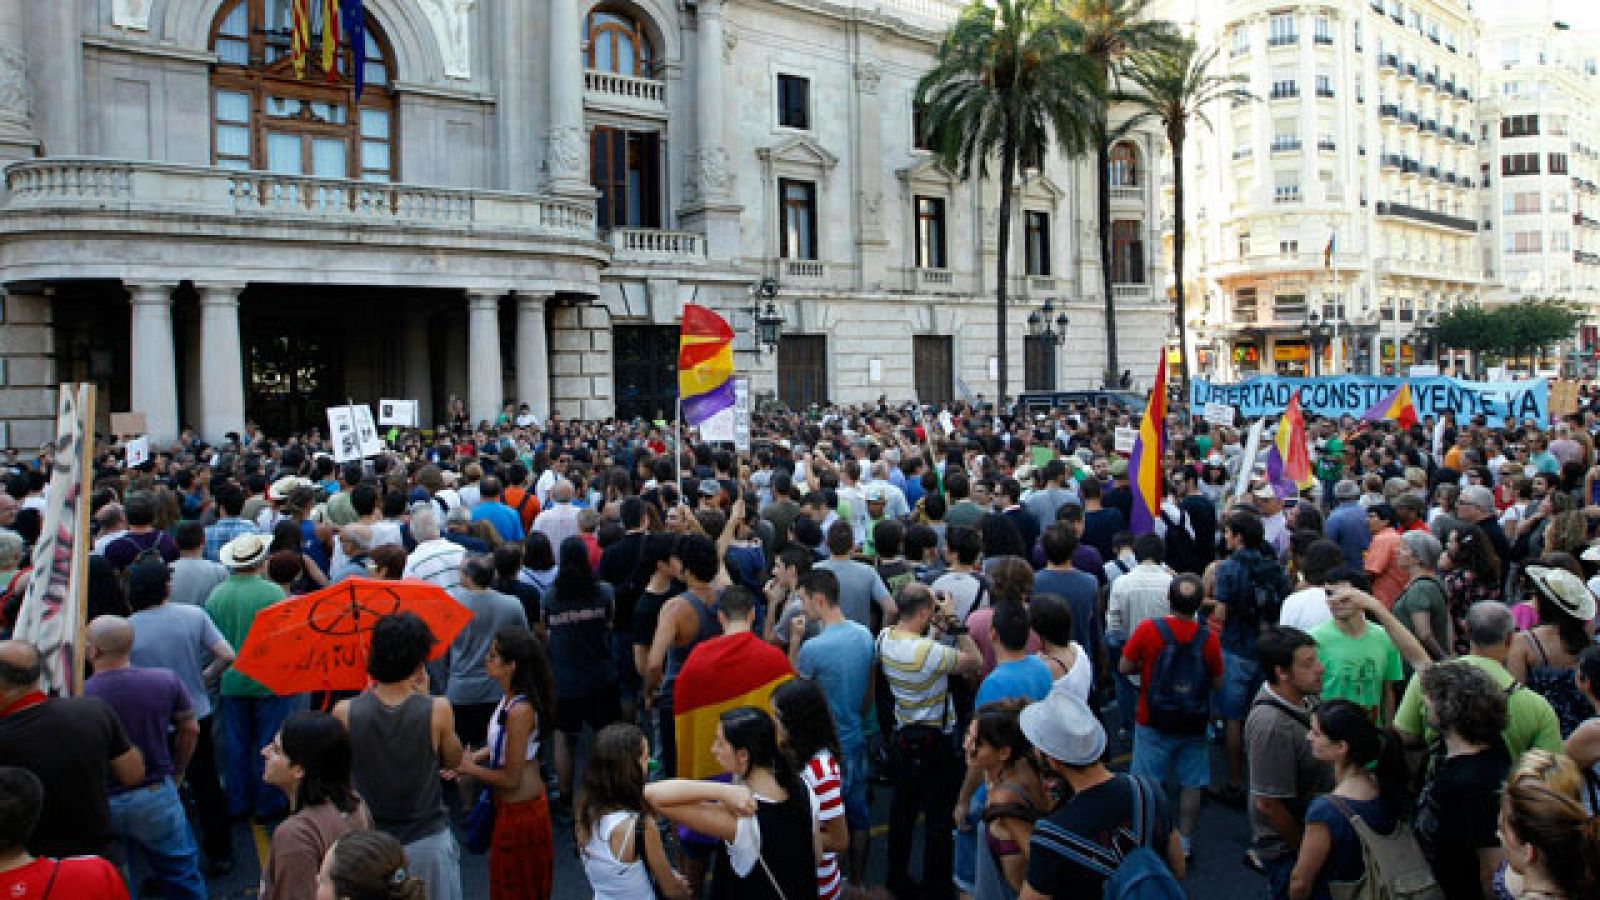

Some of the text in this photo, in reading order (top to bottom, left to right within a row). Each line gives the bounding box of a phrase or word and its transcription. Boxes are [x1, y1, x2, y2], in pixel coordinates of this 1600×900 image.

[1194, 383, 1541, 418] LIBERTAD CONSTITYENTE YA
